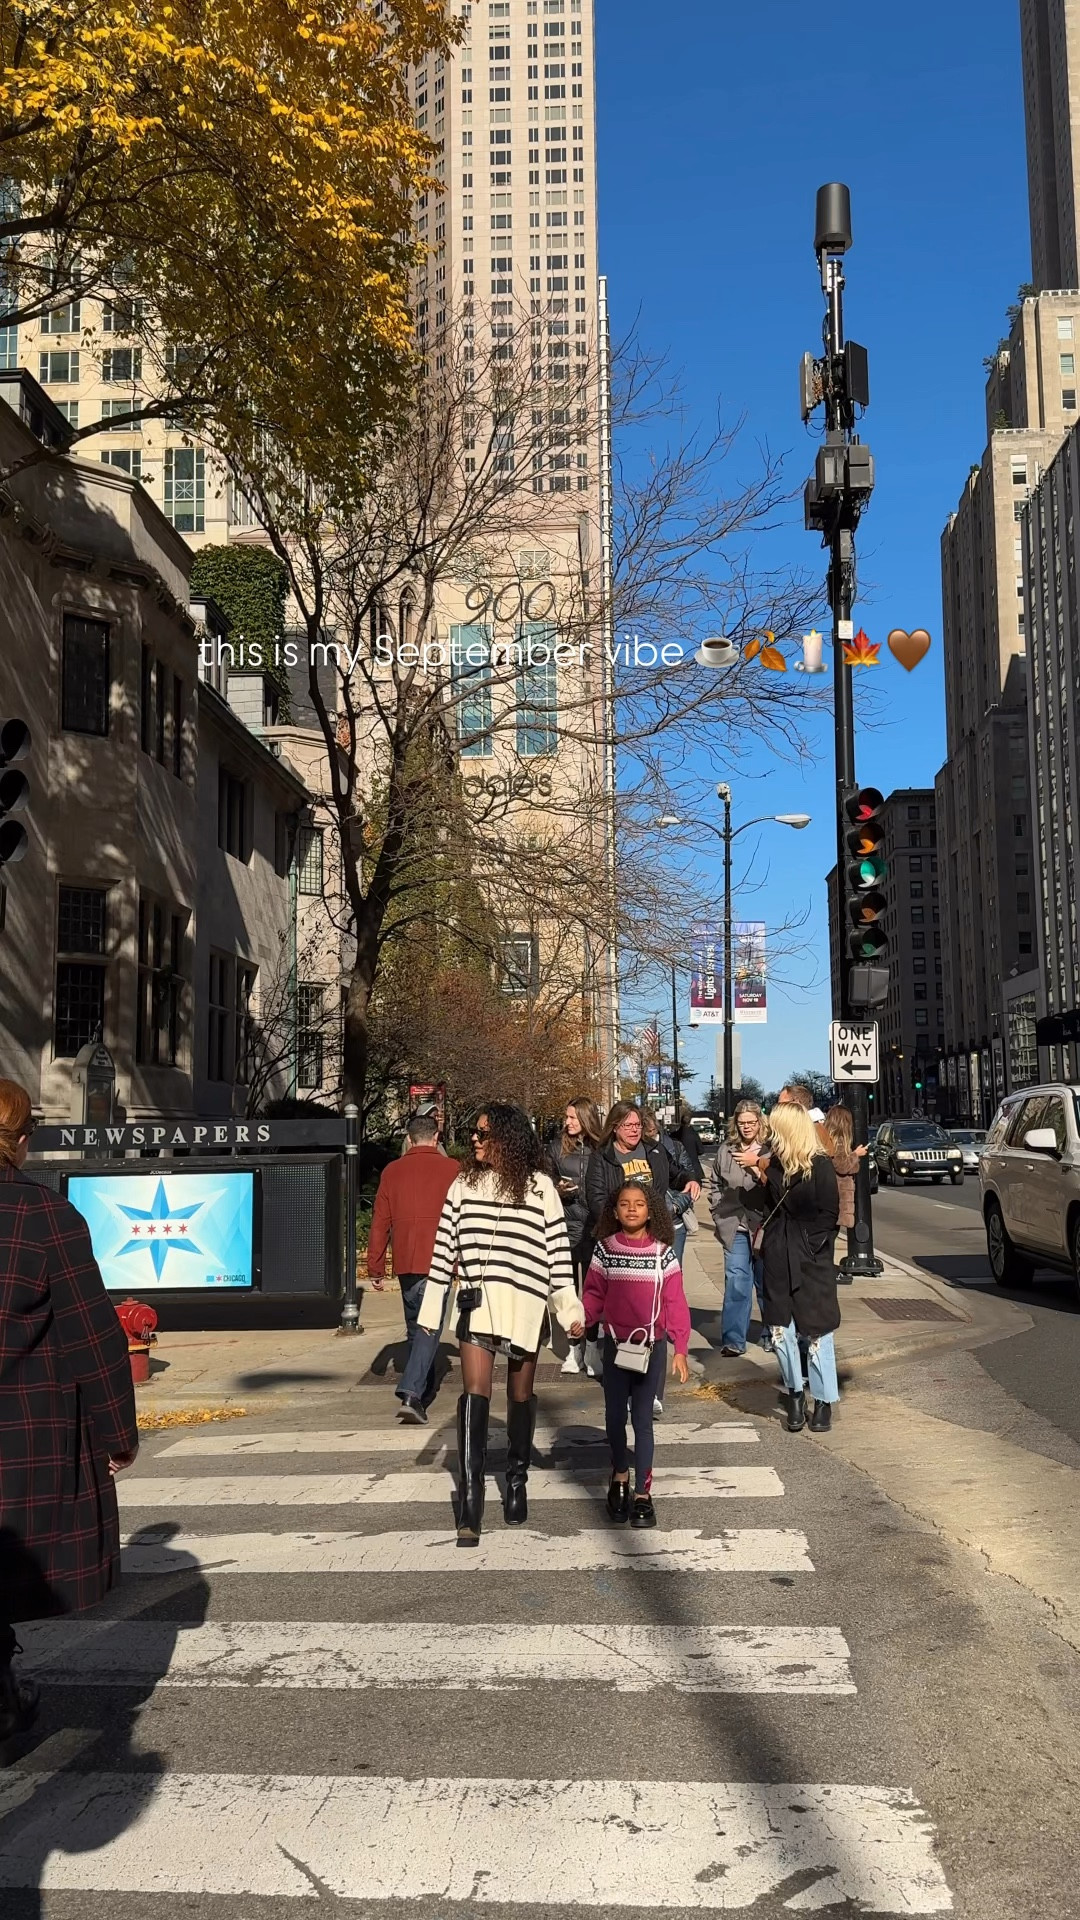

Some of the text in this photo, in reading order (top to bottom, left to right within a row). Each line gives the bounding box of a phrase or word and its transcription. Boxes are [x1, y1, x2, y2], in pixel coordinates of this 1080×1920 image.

[465, 581, 557, 626] 900
[838, 1026, 872, 1041] ONE
[837, 1043, 873, 1057] WAY
[60, 1124, 270, 1146] NEWSPAPERS
[223, 1274, 246, 1282] CHICAGO
